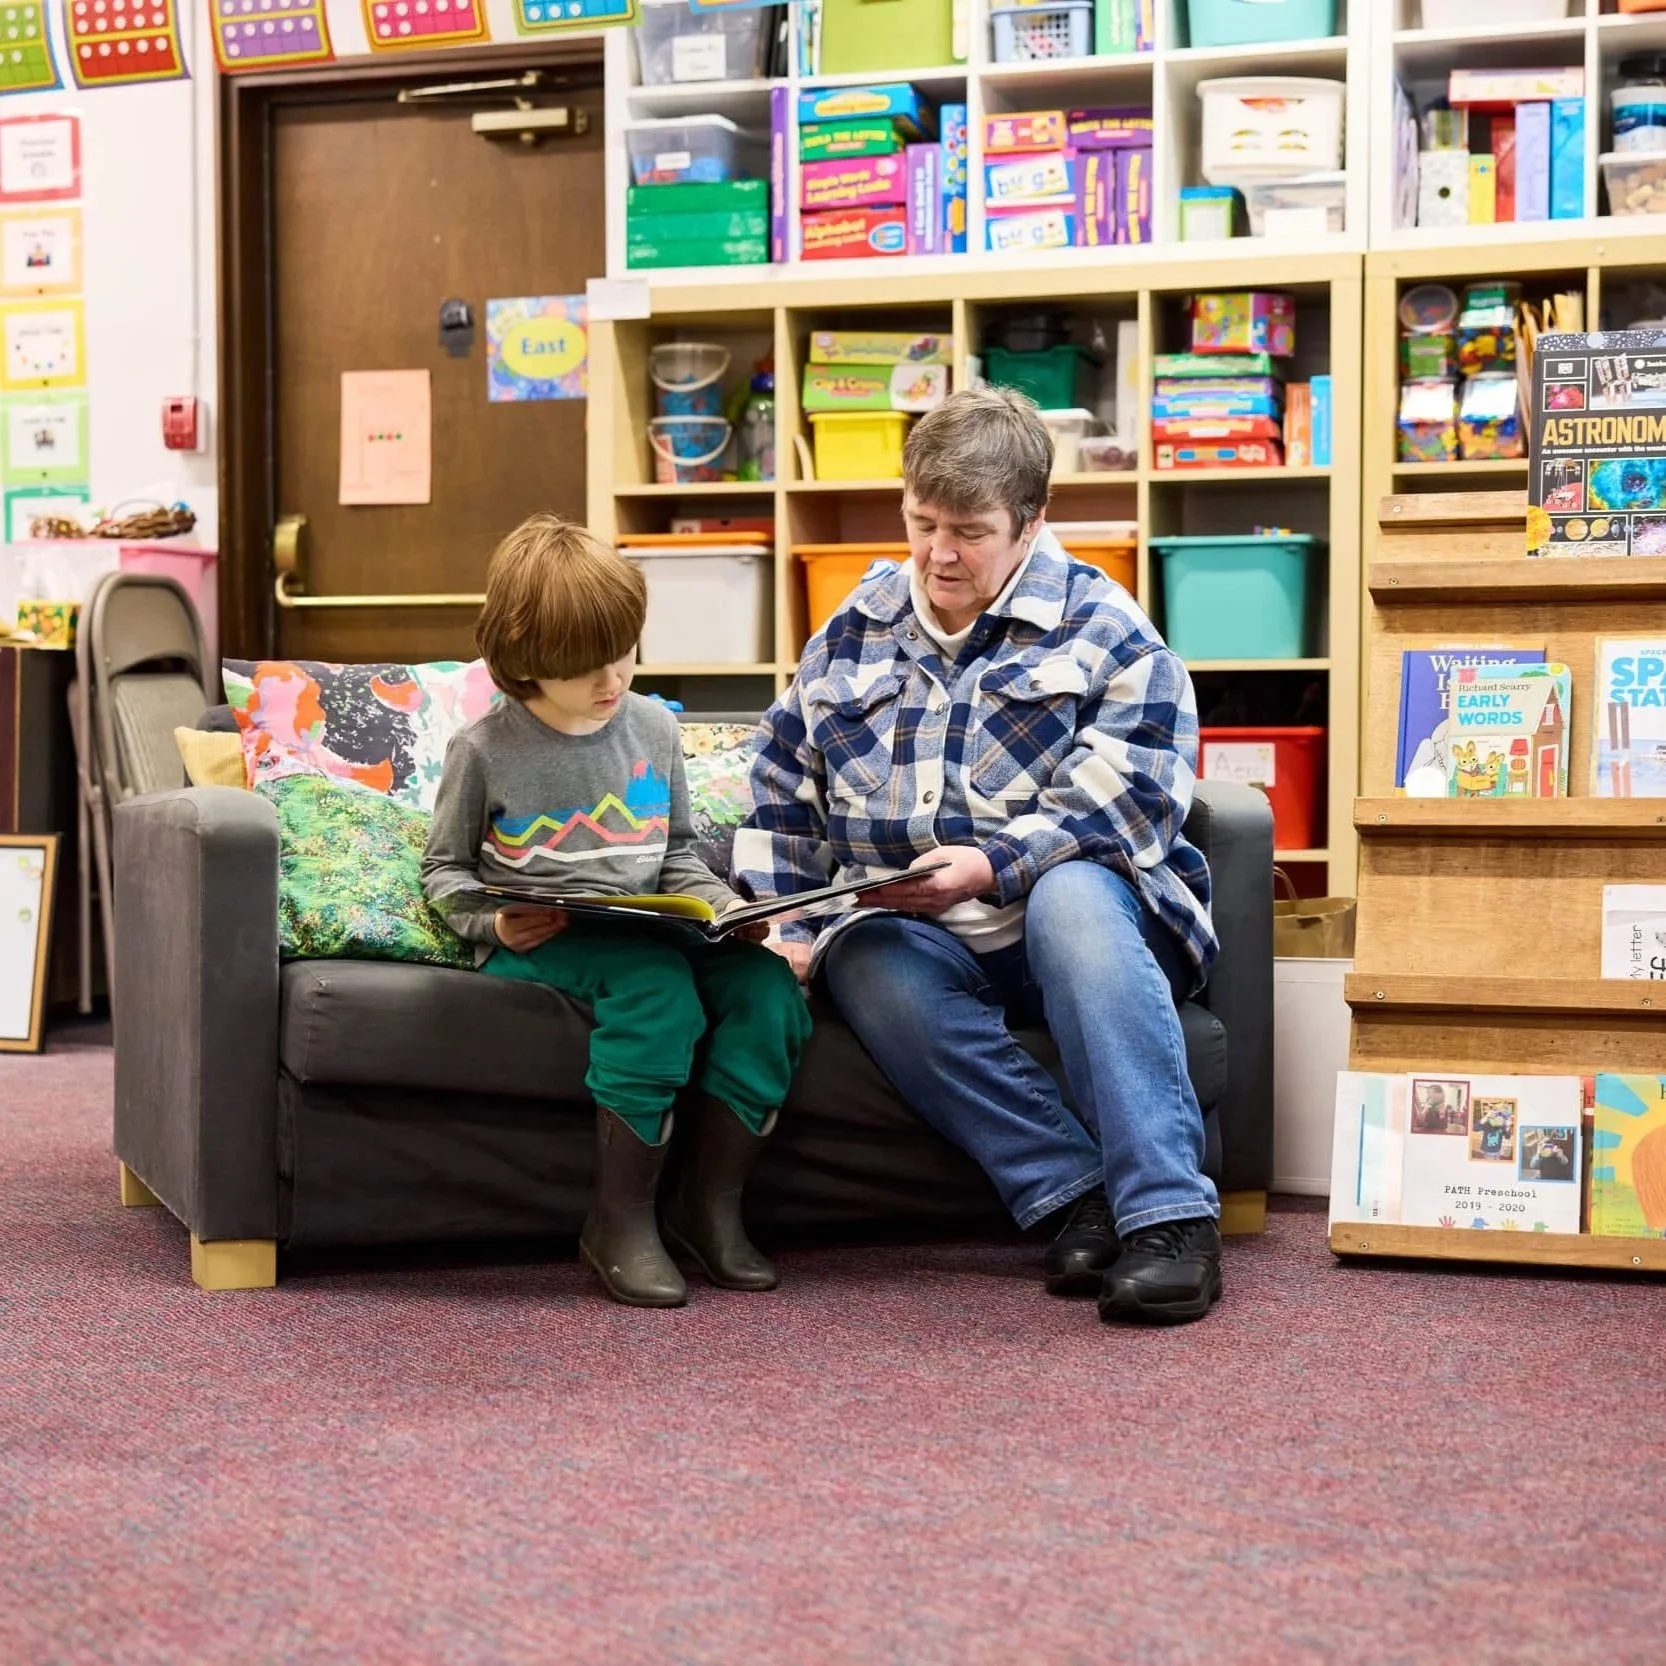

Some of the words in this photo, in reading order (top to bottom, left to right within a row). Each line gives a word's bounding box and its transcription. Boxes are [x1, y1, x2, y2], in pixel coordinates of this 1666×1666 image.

[521, 337, 565, 354] East
[1542, 415, 1666, 446] ASTRONOM
[1610, 657, 1666, 687] SP
[1458, 683, 1499, 692] Richard
[1500, 682, 1532, 693] Scarry
[1458, 694, 1511, 708] EARLY
[1458, 711, 1523, 725] WORDS
[1629, 924, 1643, 962] letter
[1443, 1185, 1471, 1195] PATH
[1478, 1187, 1537, 1198] Preschool
[1455, 1200, 1481, 1210] 2019
[1498, 1203, 1526, 1212] 2020
